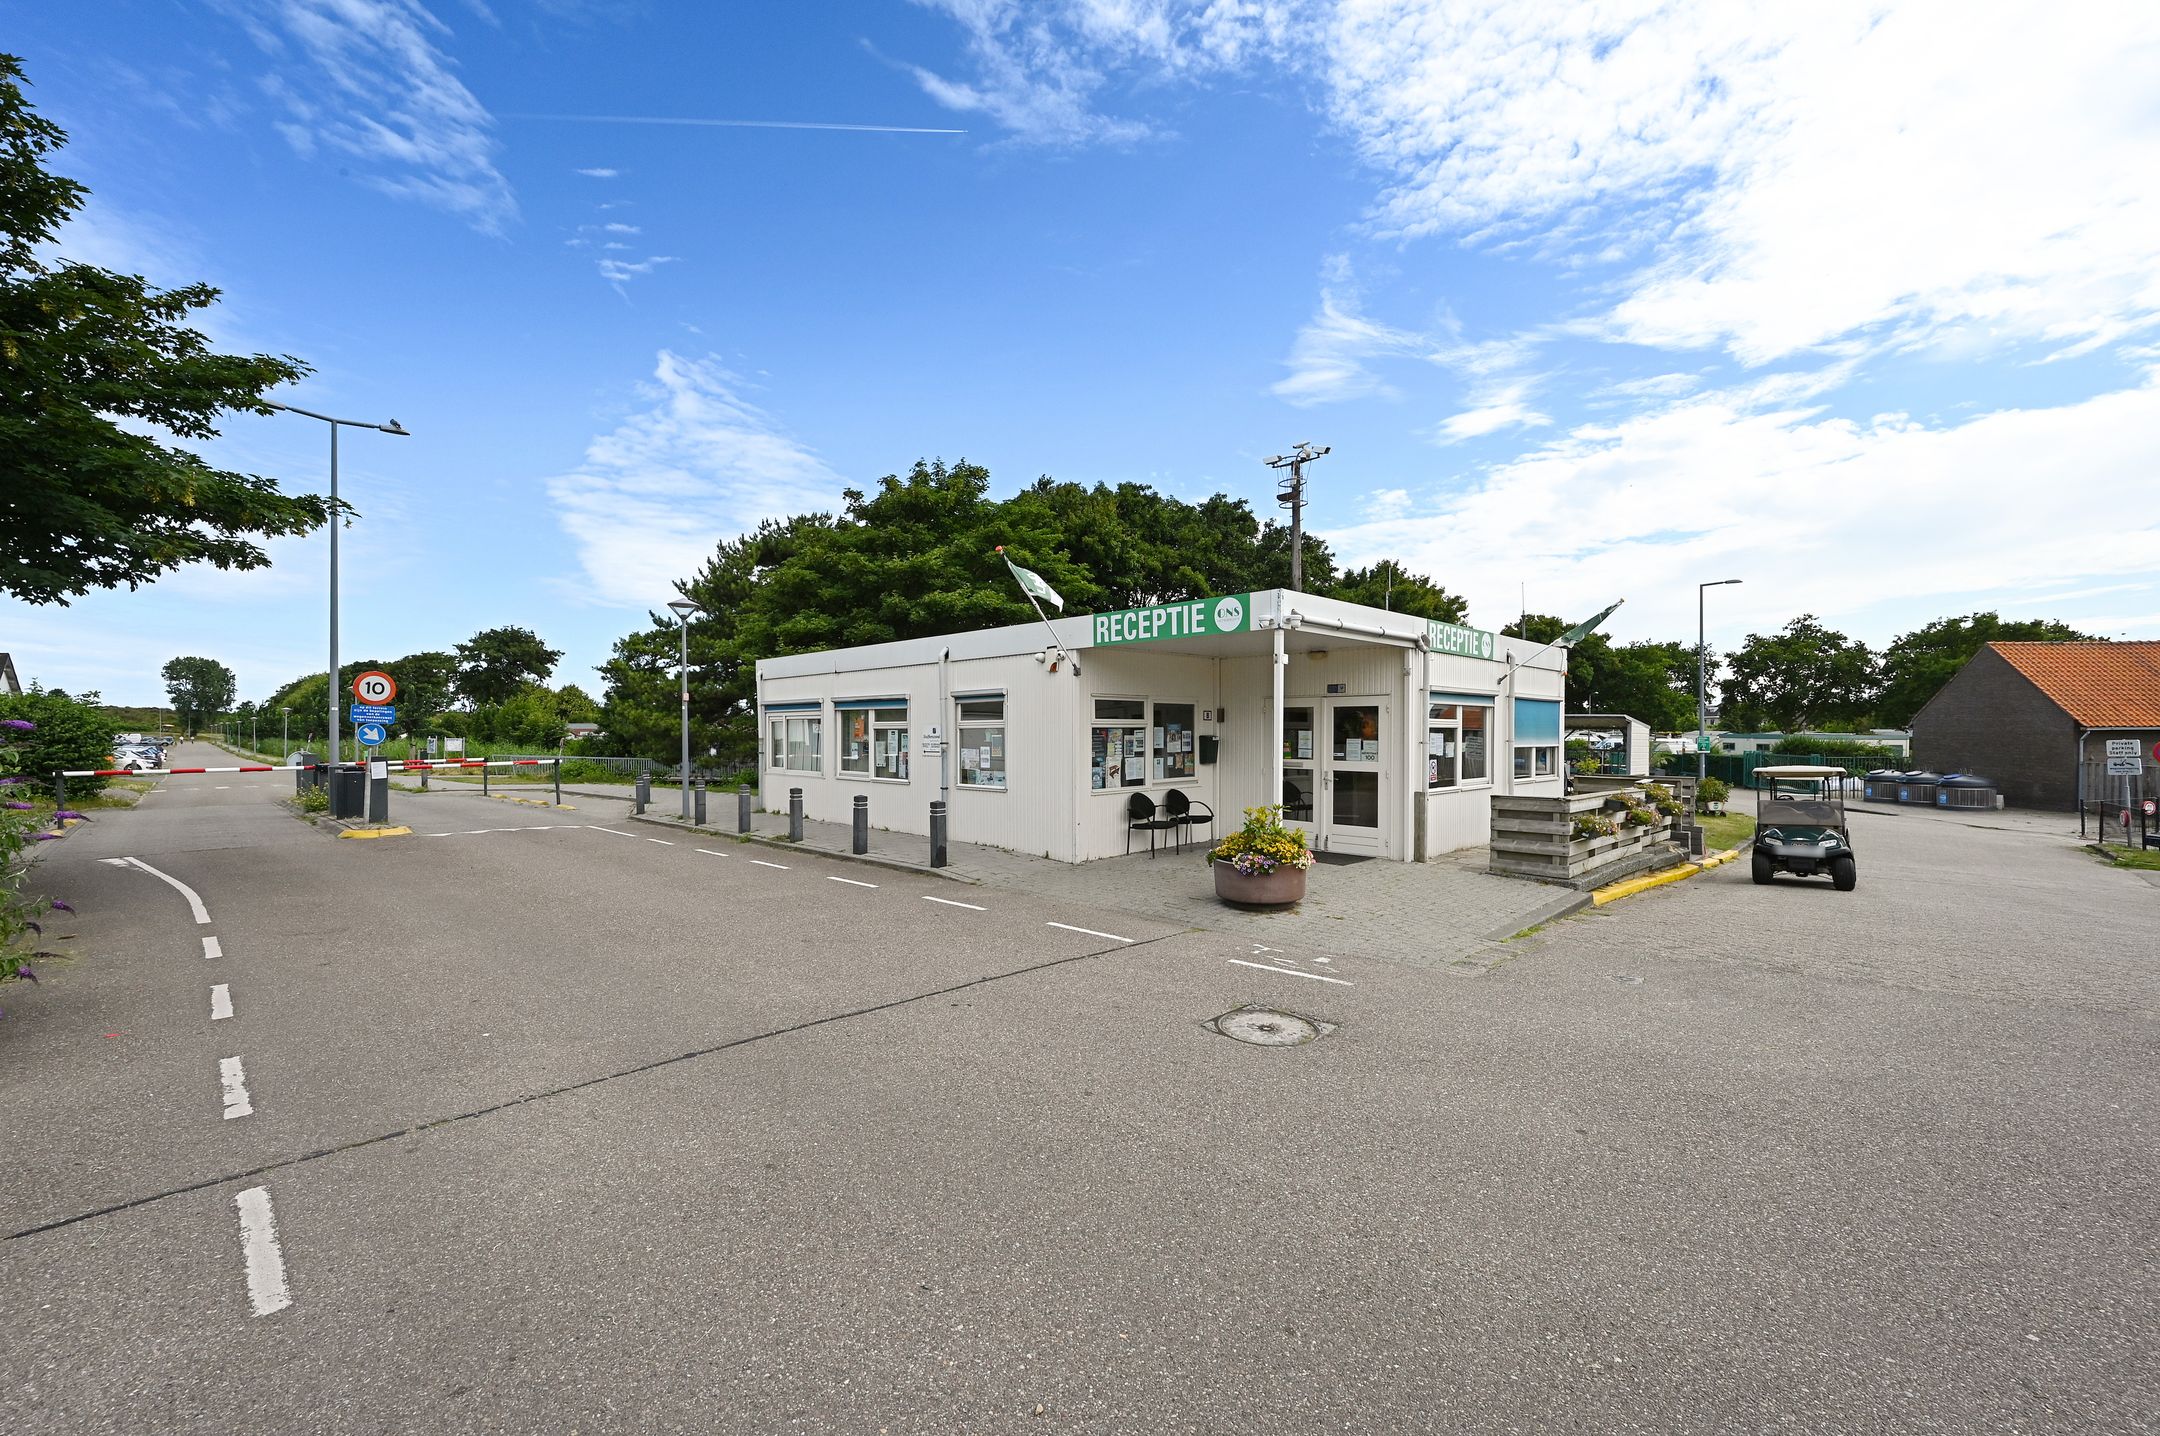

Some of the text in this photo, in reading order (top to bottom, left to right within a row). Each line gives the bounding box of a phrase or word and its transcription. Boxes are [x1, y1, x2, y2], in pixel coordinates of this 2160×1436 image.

[1096, 603, 1206, 644] RECEPTIE
[1217, 606, 1240, 619] ONS
[1429, 622, 1479, 655] RECEPTIE
[365, 681, 385, 695] 10
